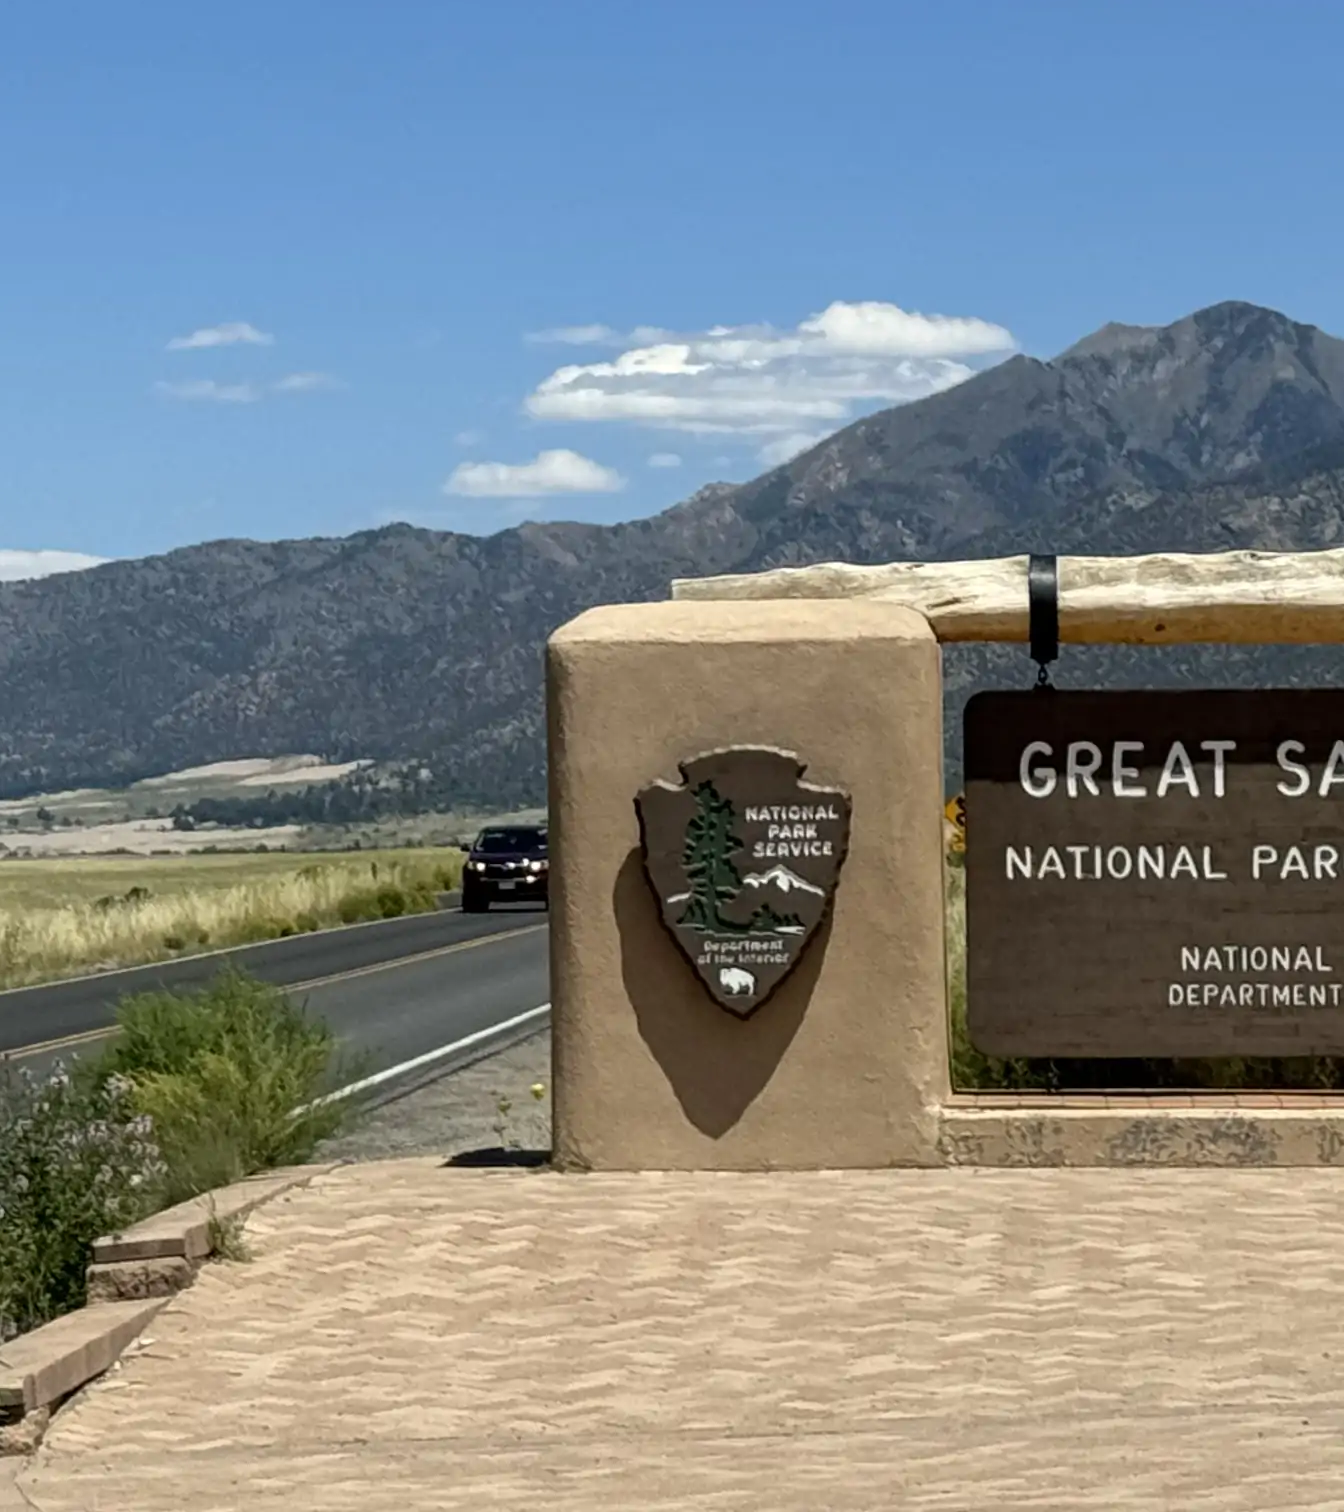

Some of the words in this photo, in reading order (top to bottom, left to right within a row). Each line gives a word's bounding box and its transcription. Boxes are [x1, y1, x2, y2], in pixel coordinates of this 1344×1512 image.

[1019, 740, 1238, 799] GREAT
[745, 805, 839, 821] NATIONAL
[767, 824, 818, 839] PARK
[752, 842, 834, 858] SERVICE
[1005, 845, 1229, 881] NATIONAL
[1181, 945, 1334, 973] NATIONAL
[1168, 983, 1343, 1009] DEPARTMENT
